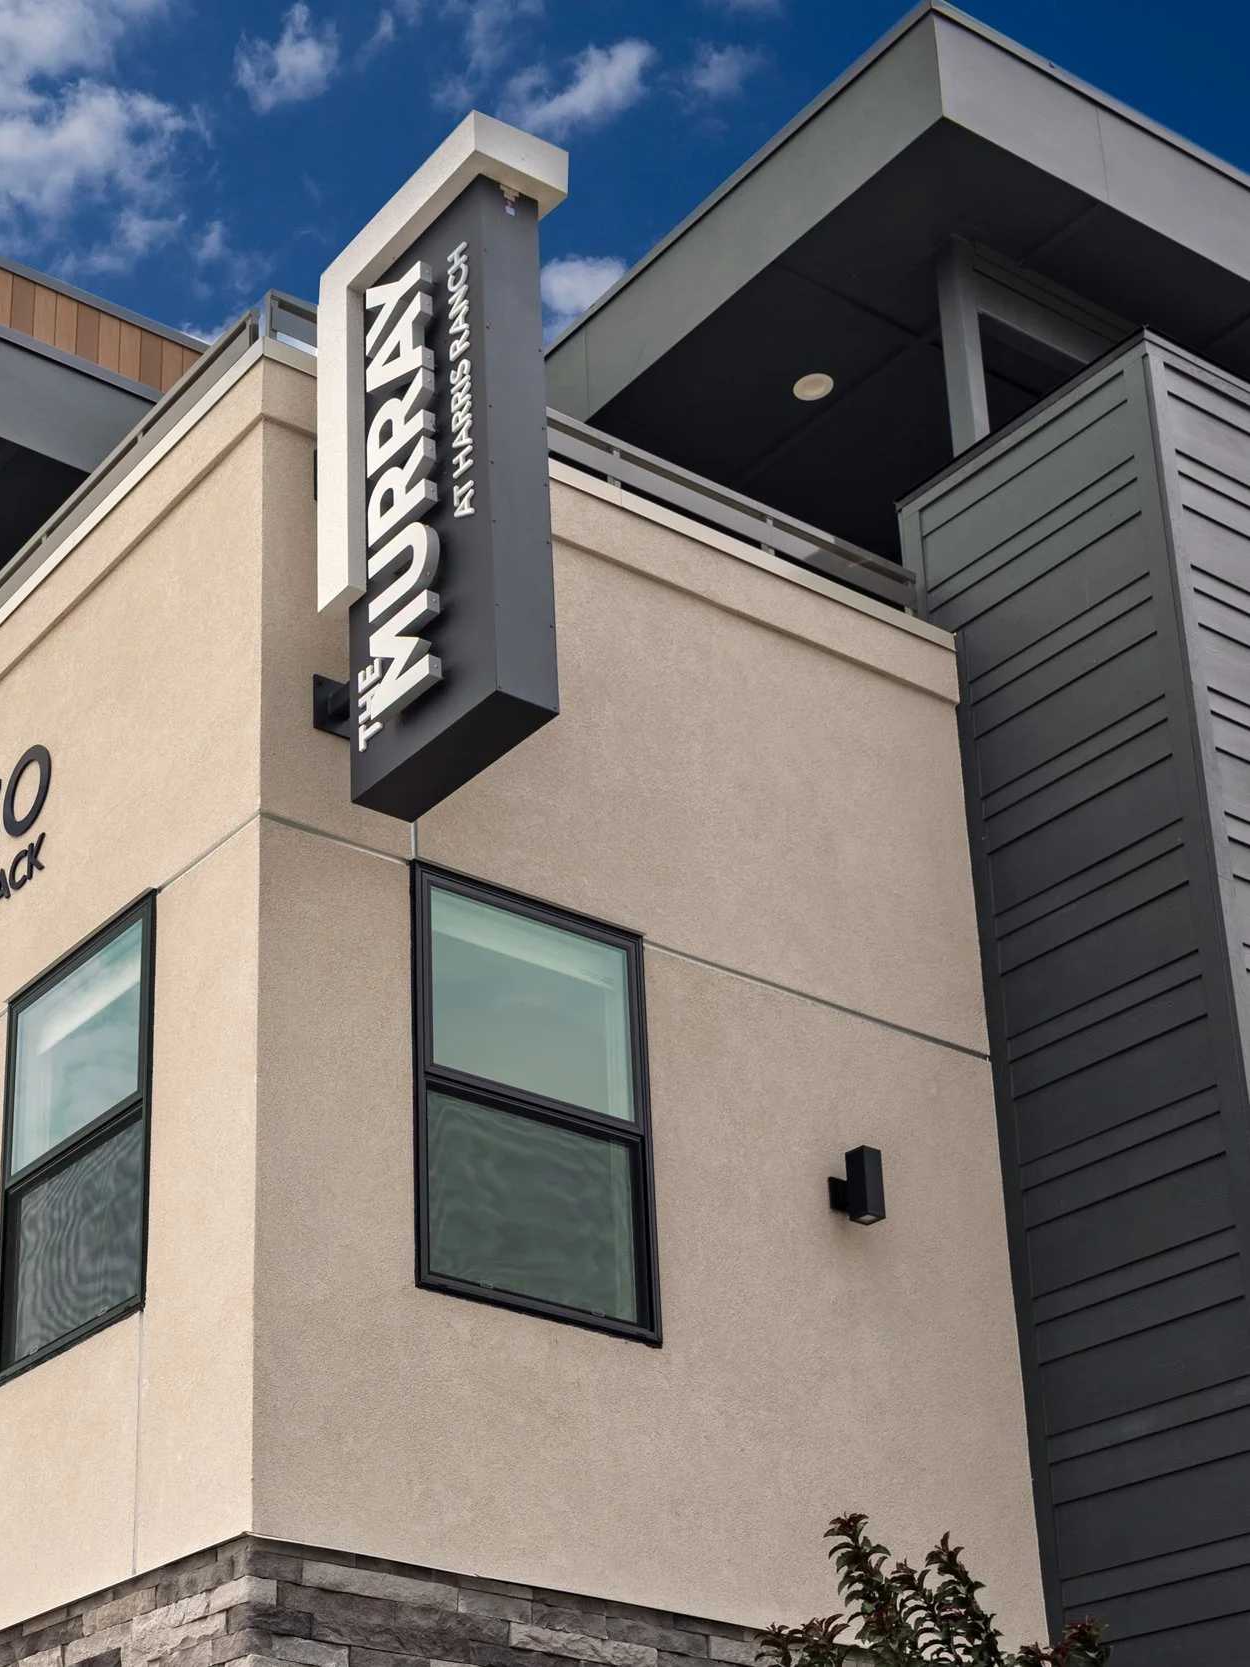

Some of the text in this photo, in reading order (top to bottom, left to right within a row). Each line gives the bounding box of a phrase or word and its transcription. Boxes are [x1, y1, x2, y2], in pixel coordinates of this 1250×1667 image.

[365, 260, 439, 721] MURRAY
[447, 241, 475, 518] AT HARRIS RANCH
[358, 657, 383, 752] THE
